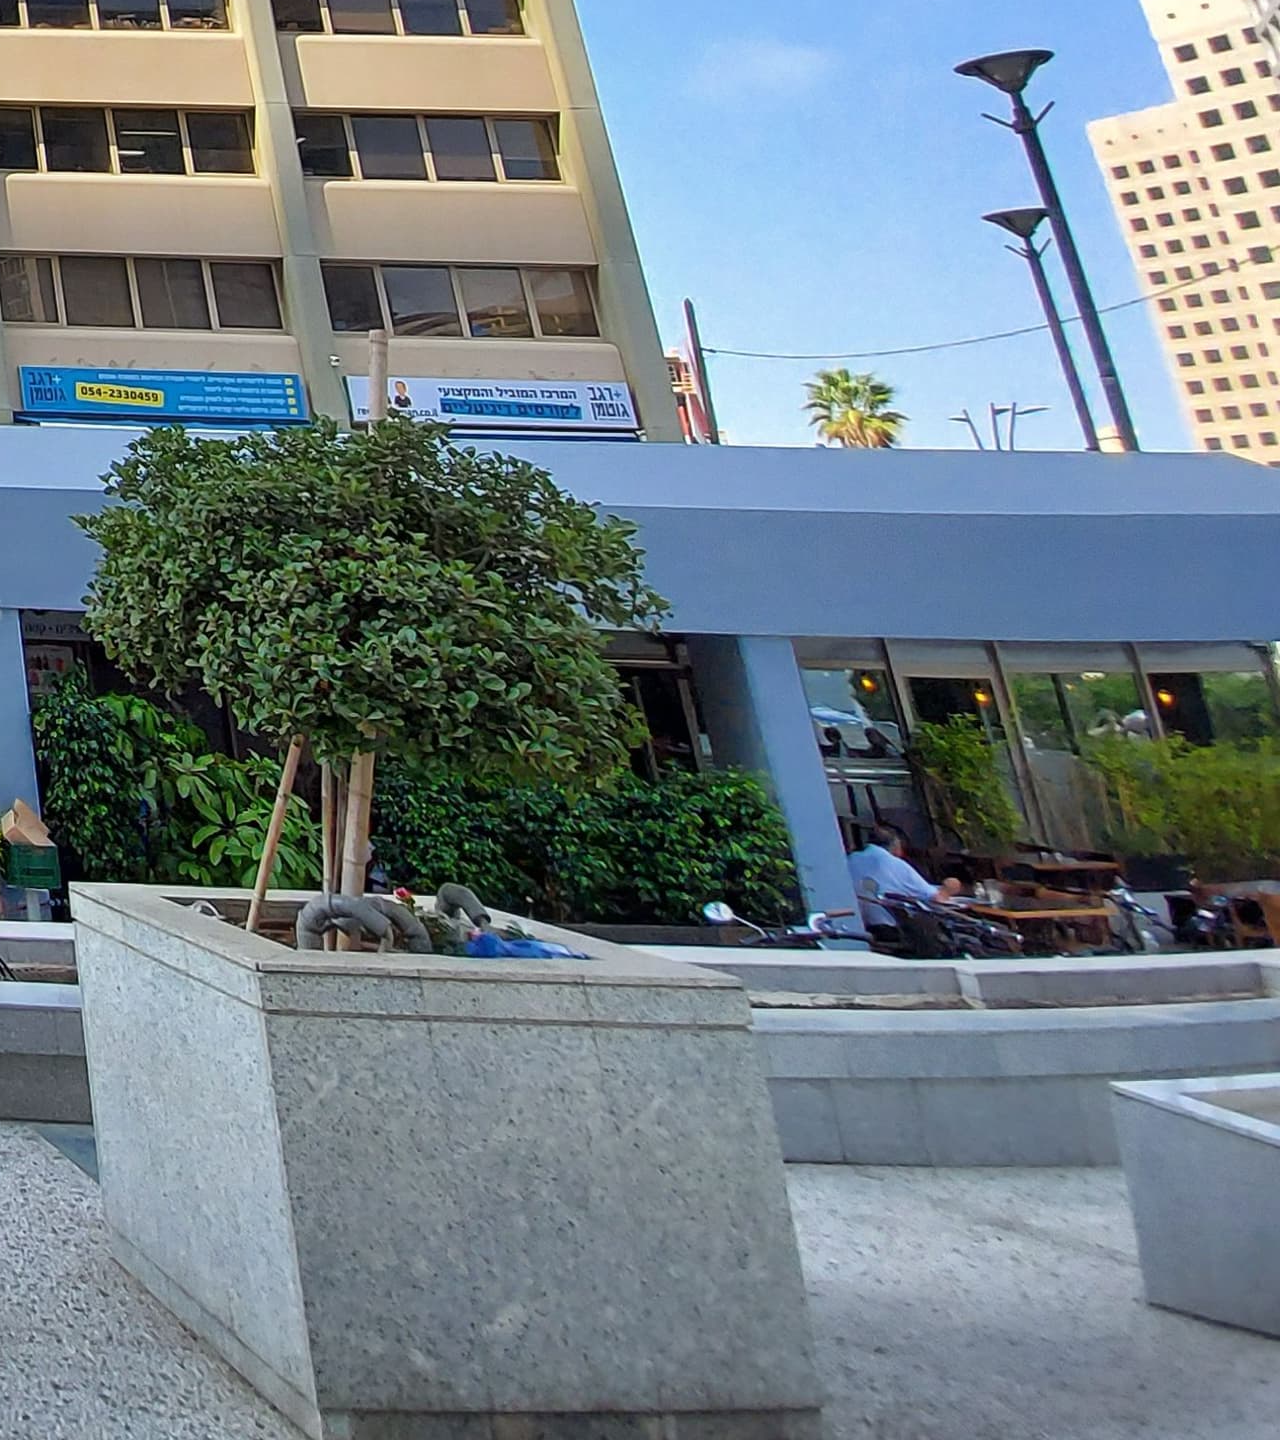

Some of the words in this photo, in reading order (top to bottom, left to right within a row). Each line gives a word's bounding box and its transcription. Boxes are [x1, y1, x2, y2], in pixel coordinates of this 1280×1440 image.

[30, 386, 67, 405] גוטמן
[80, 385, 159, 403] 054-2330459
[438, 386, 493, 401] והמקצועי
[495, 386, 537, 399] המוביל
[540, 388, 577, 400] המרכז
[591, 401, 630, 420] גוטמן
